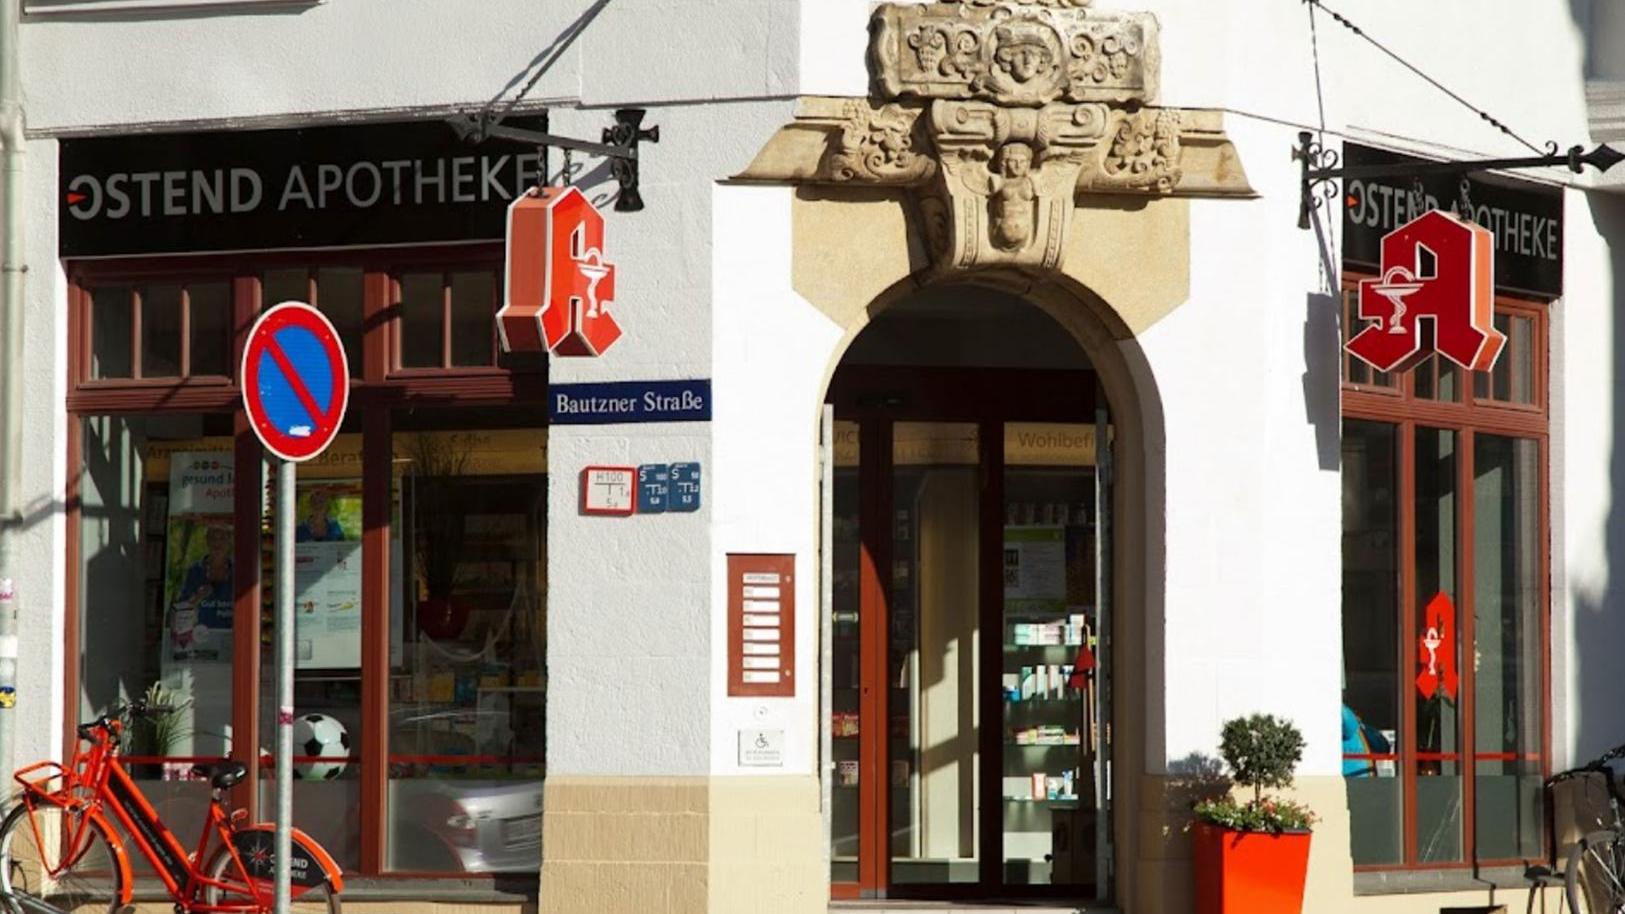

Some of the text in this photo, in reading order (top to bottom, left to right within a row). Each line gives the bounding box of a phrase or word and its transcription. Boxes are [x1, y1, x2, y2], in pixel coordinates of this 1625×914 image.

[67, 167, 263, 220] OSTEND
[556, 390, 703, 414] Bautzner Straße
[639, 470, 648, 482] S
[672, 467, 681, 481] S
